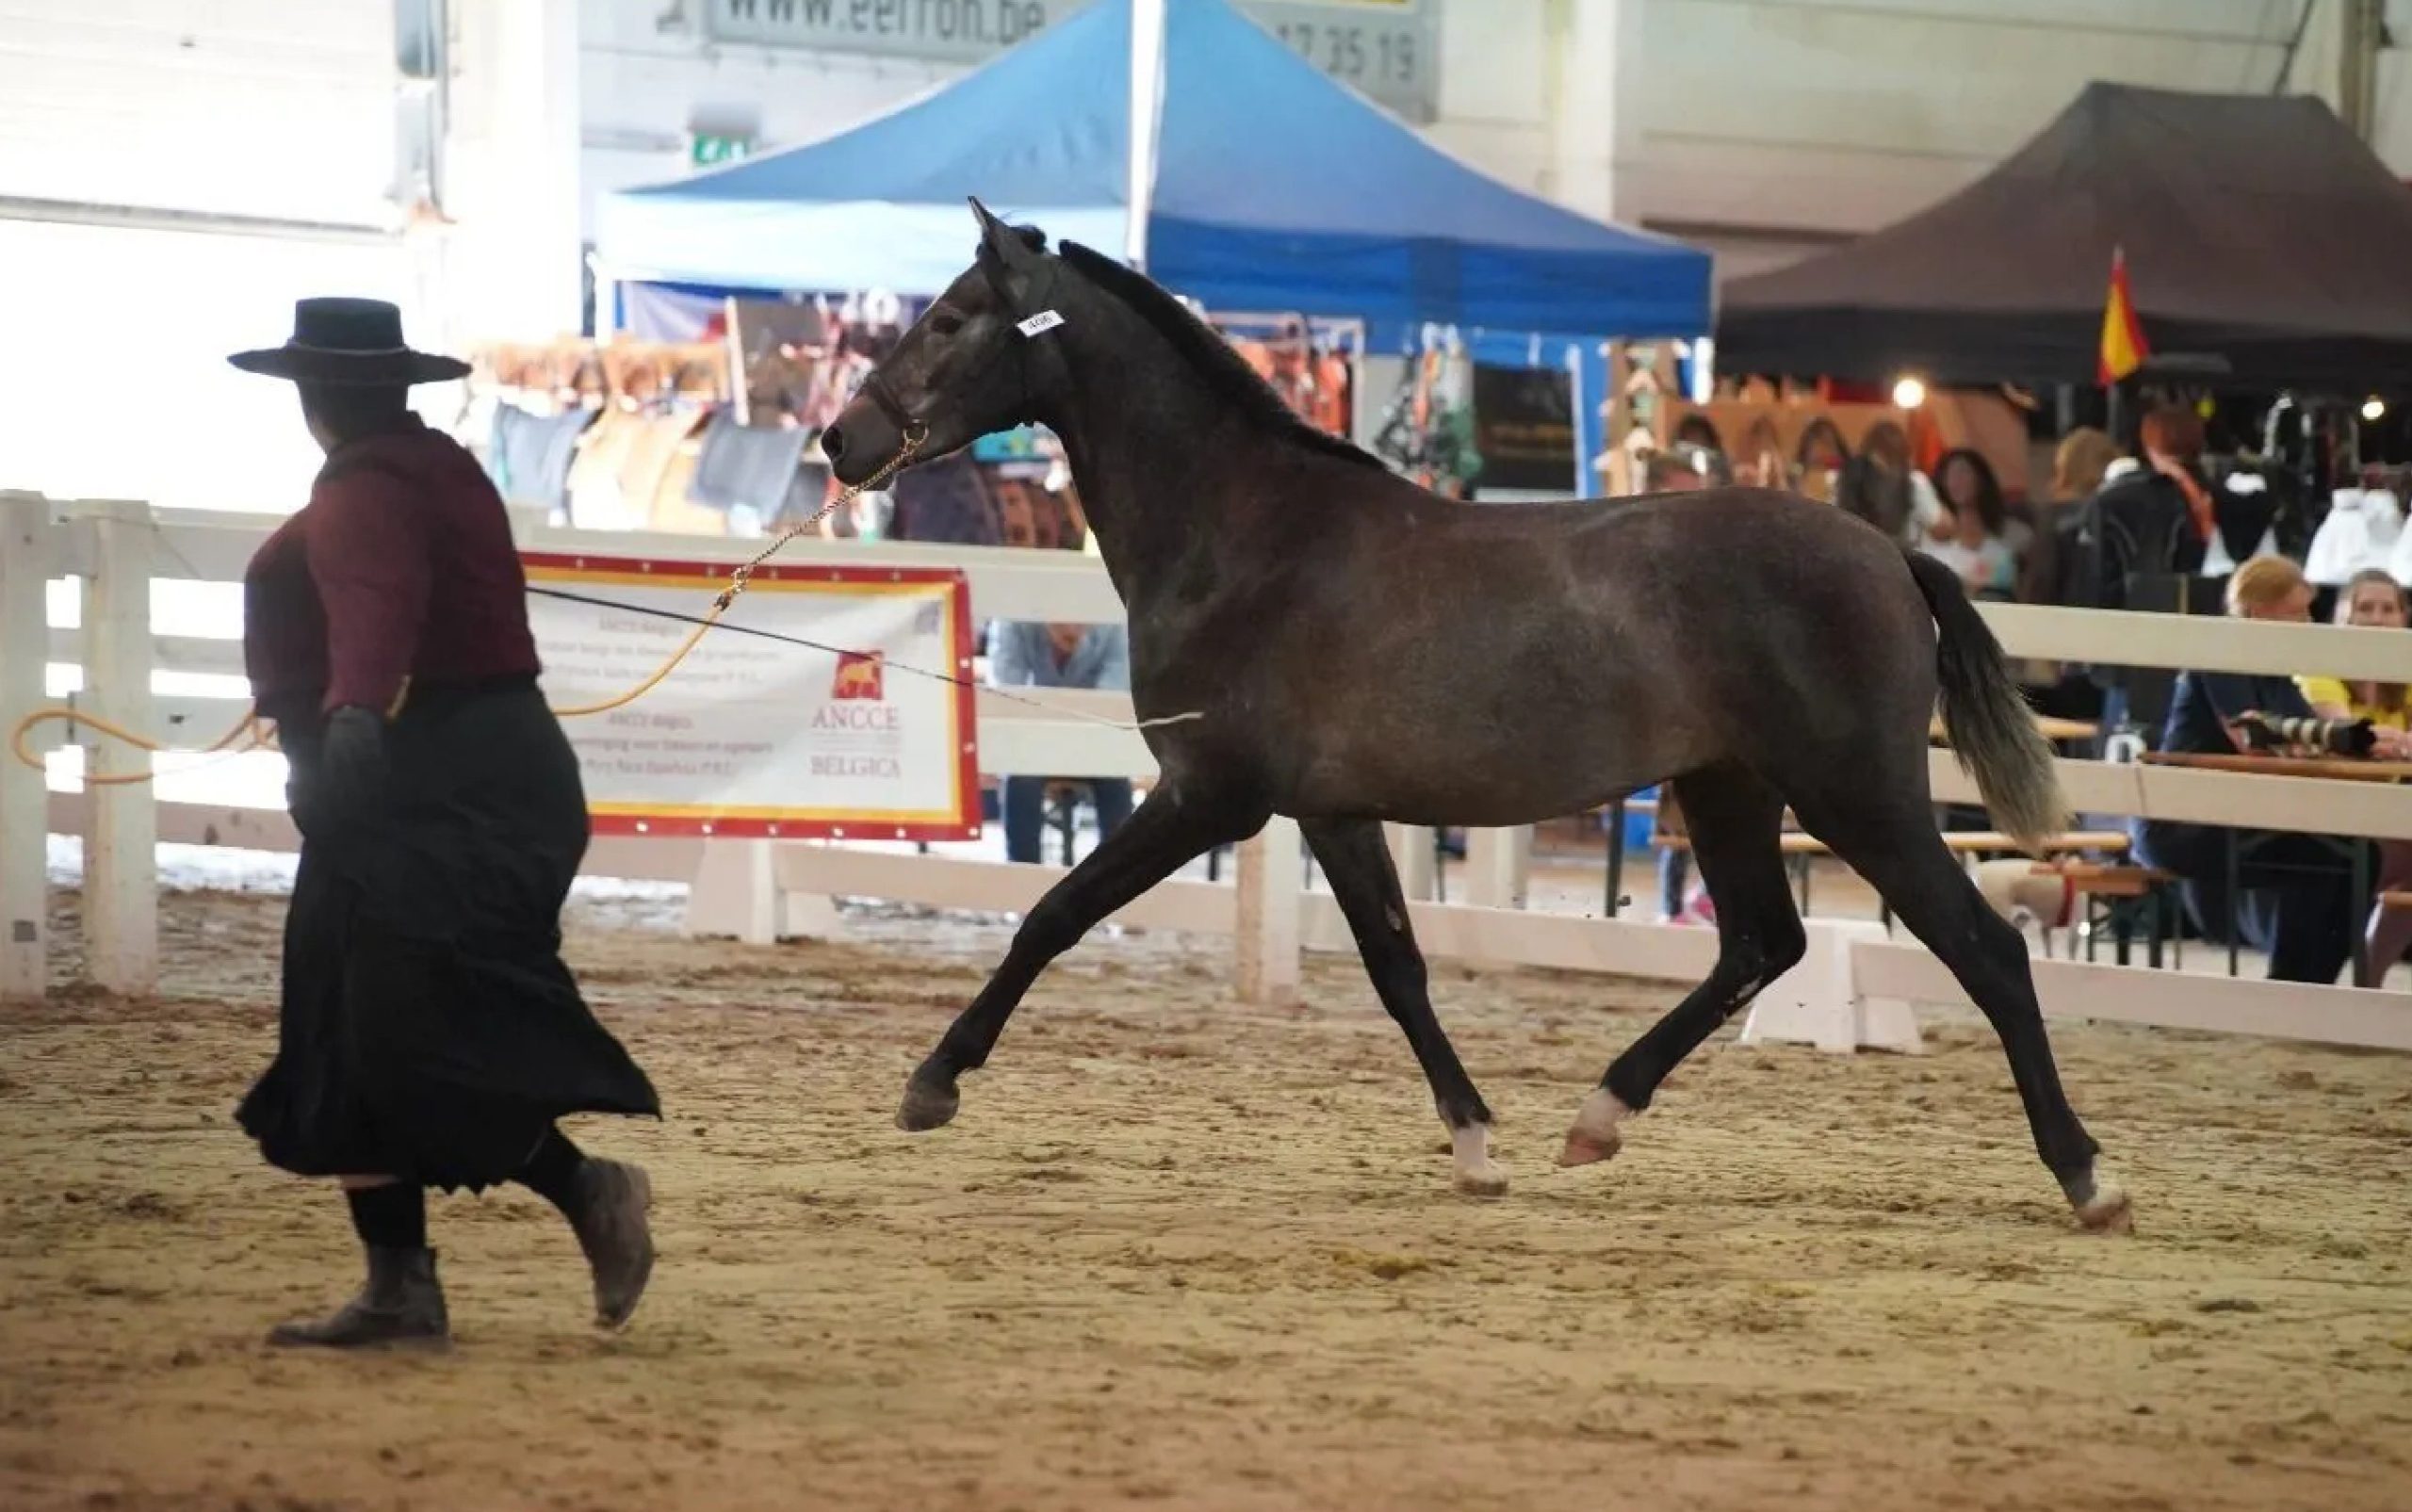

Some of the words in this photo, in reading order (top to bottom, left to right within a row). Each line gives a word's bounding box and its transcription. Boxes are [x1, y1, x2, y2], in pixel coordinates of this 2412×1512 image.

[1377, 32, 1415, 82] 19
[811, 706, 901, 730] ANCCE
[810, 756, 900, 778] BELGICA
